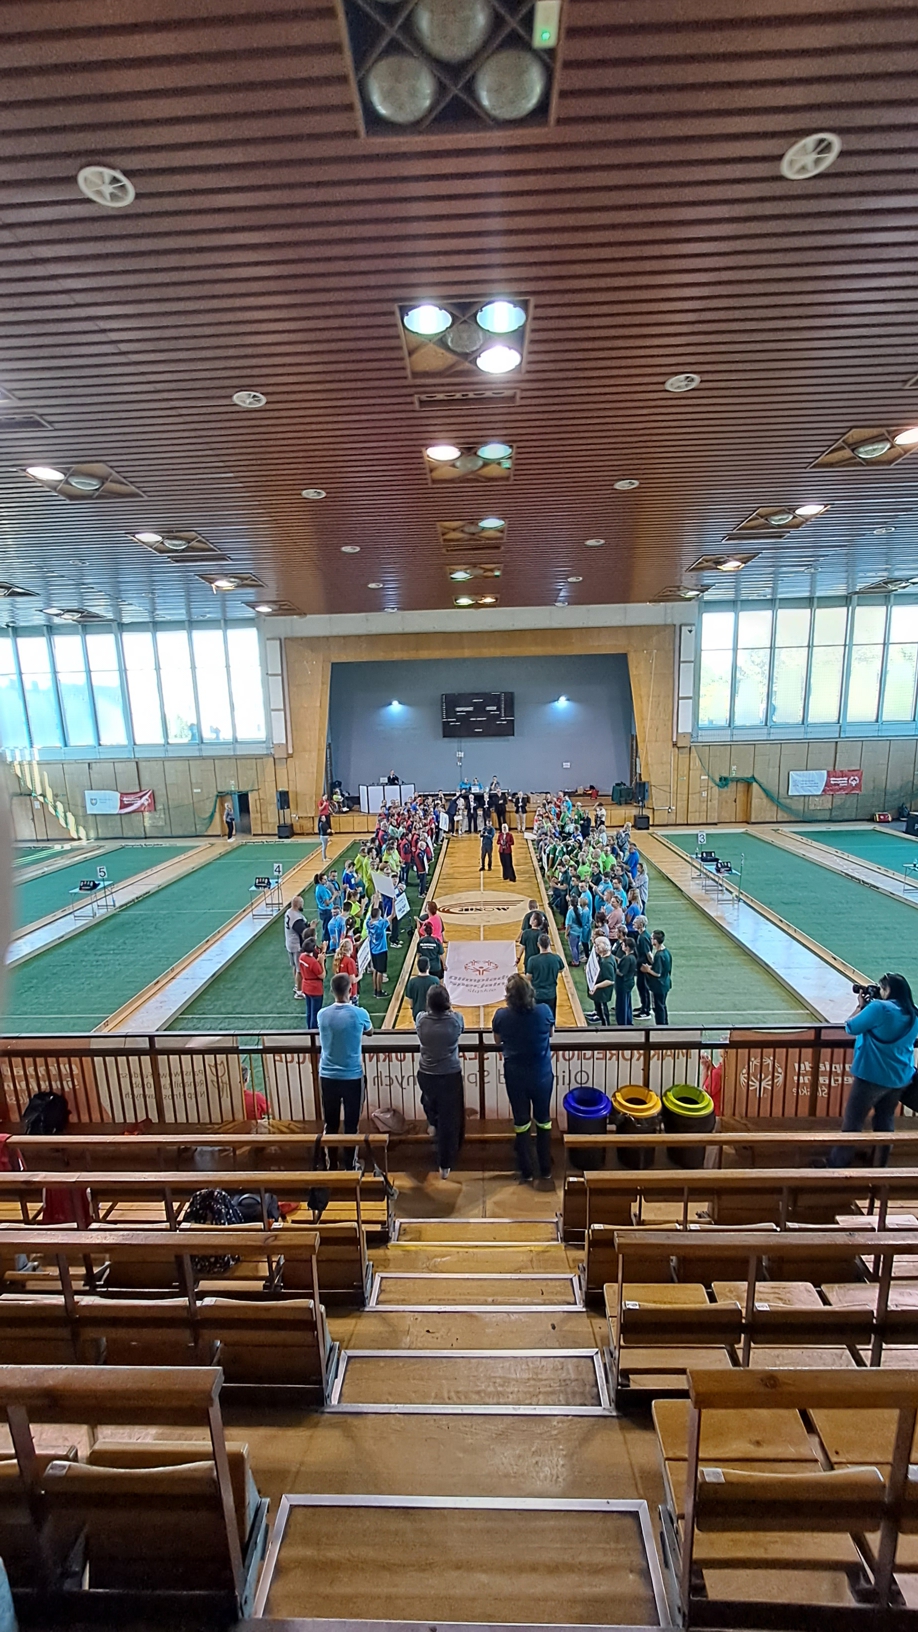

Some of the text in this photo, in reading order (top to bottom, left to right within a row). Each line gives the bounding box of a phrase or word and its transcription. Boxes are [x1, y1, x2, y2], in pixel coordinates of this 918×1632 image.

[699, 834, 705, 843] 3
[98, 868, 106, 878] 5
[275, 864, 282, 875] 4
